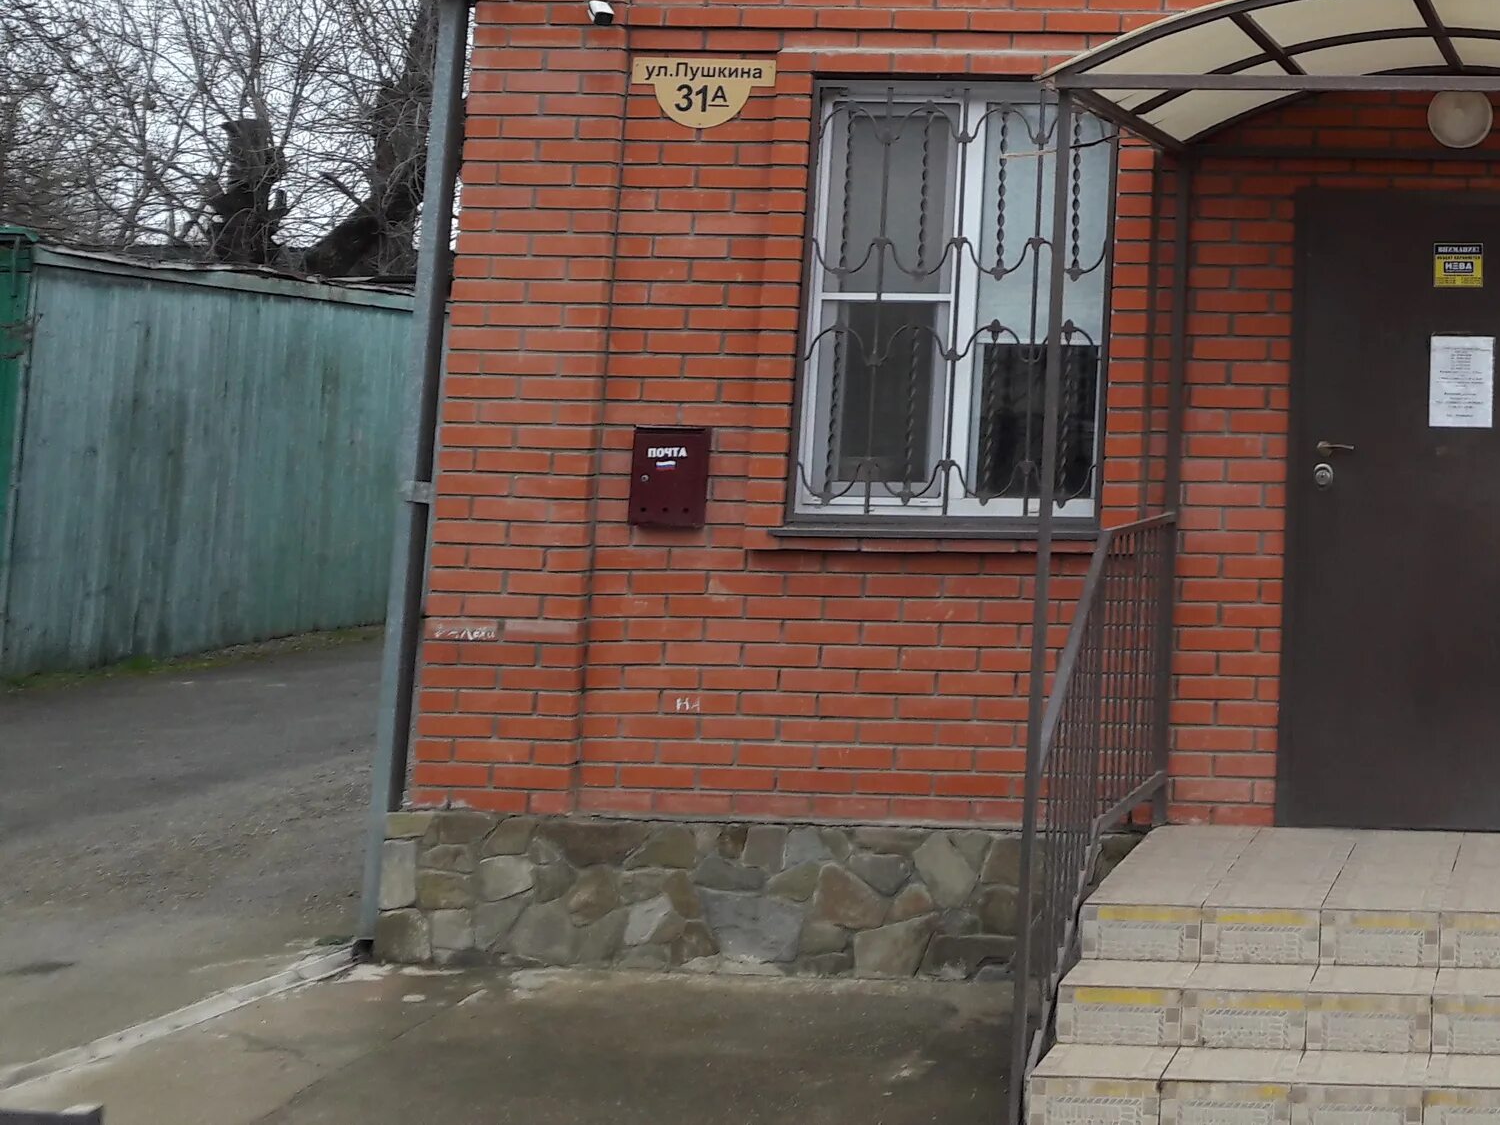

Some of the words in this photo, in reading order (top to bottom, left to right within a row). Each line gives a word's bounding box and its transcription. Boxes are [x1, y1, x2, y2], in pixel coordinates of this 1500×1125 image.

[645, 62, 763, 81] ул.Пушкина
[674, 84, 729, 112] 31А
[647, 447, 688, 458] ПОЧТА
